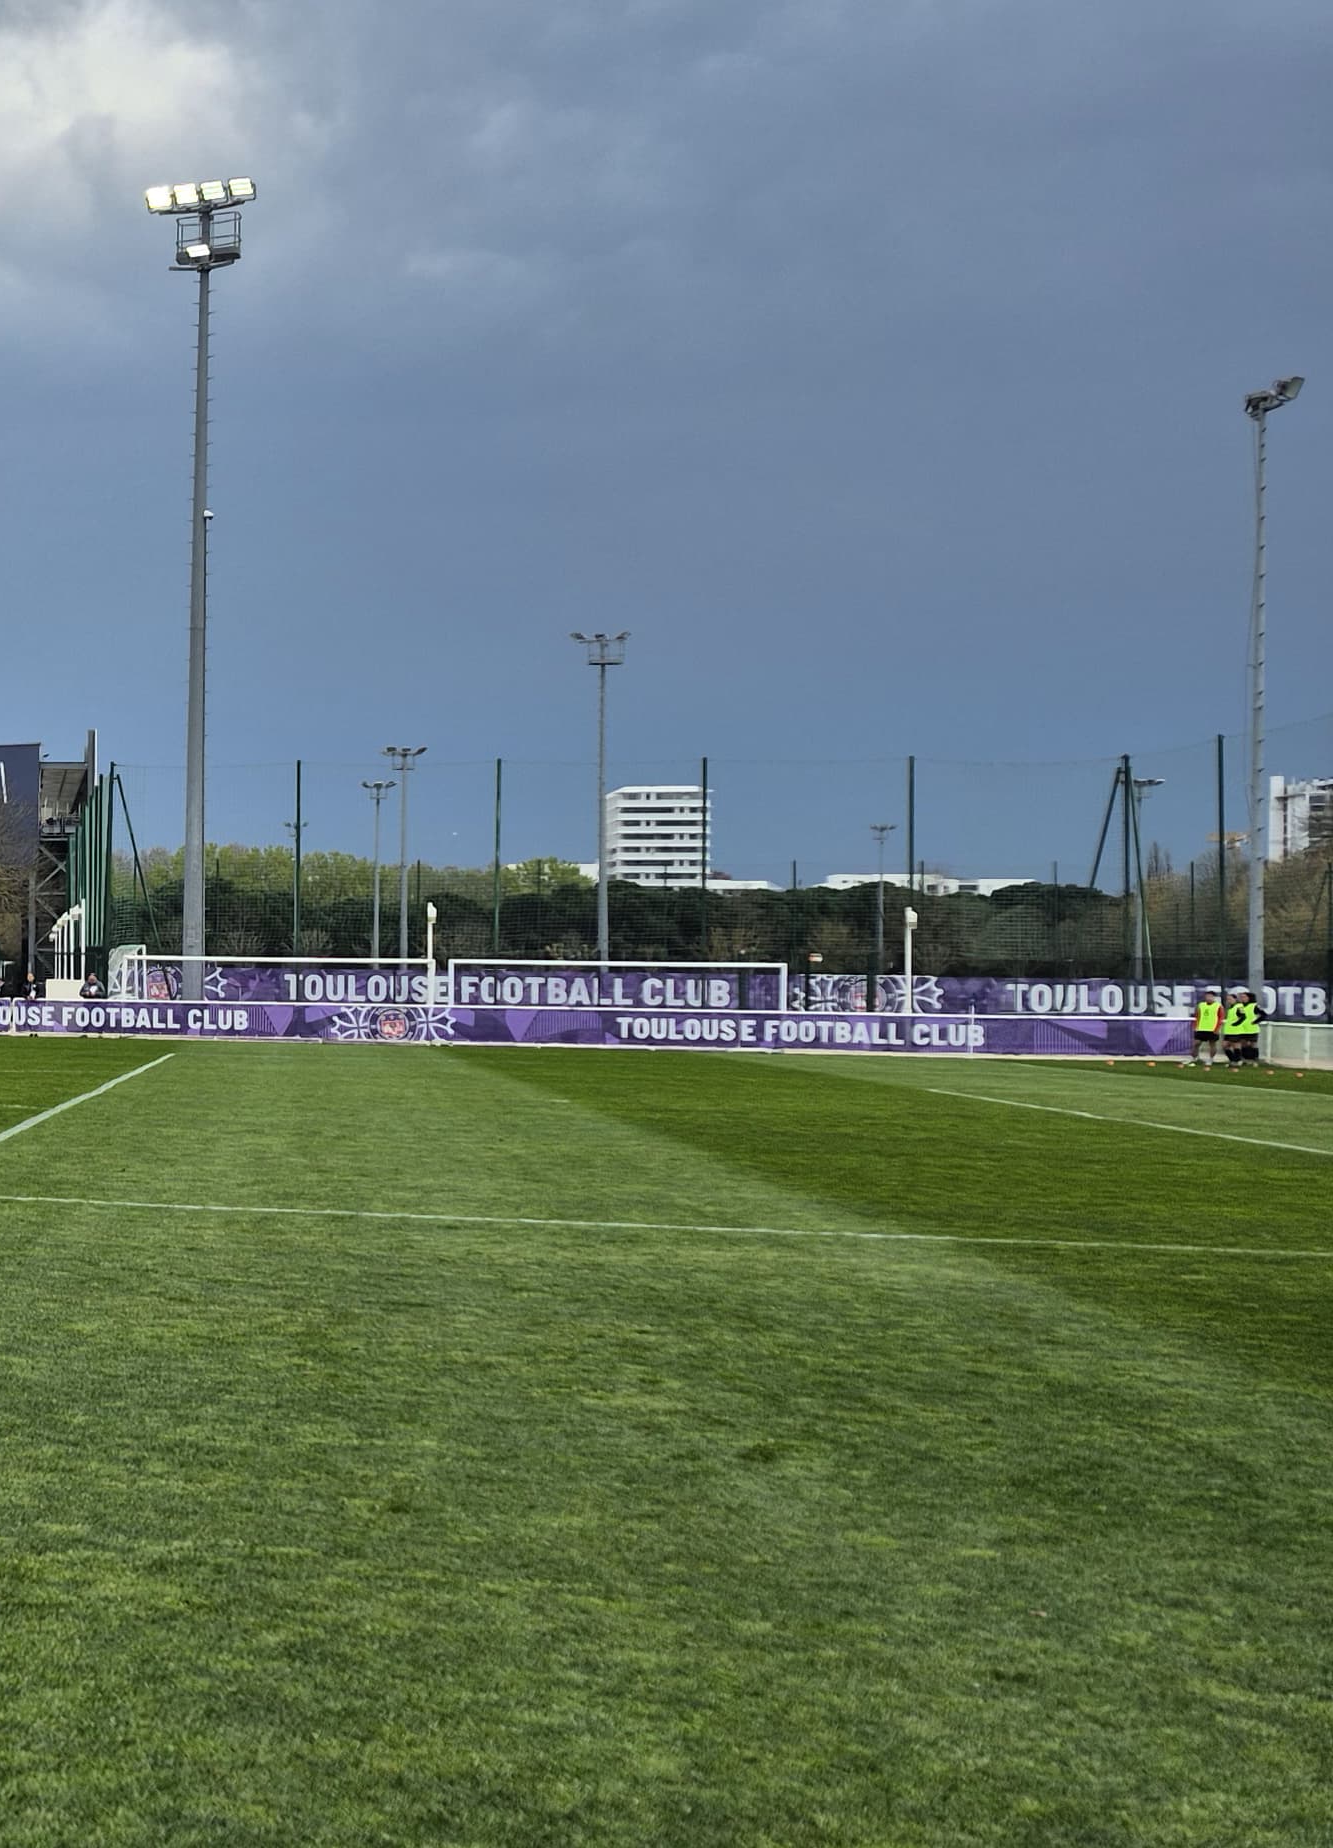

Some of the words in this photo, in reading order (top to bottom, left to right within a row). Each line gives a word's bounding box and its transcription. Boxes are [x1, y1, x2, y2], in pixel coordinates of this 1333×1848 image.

[284, 974, 452, 1002] TOULOUSE
[460, 976, 633, 1005] FOOTBALL
[642, 978, 731, 1007] CLUB
[1005, 983, 1195, 1015] TOULOUSE
[62, 1007, 181, 1029] FOOTBALL
[187, 1009, 248, 1031] CLUB
[617, 1017, 756, 1042] TOULOUSE
[764, 1020, 905, 1045] FOOTBALL
[912, 1023, 985, 1047] CLUB
